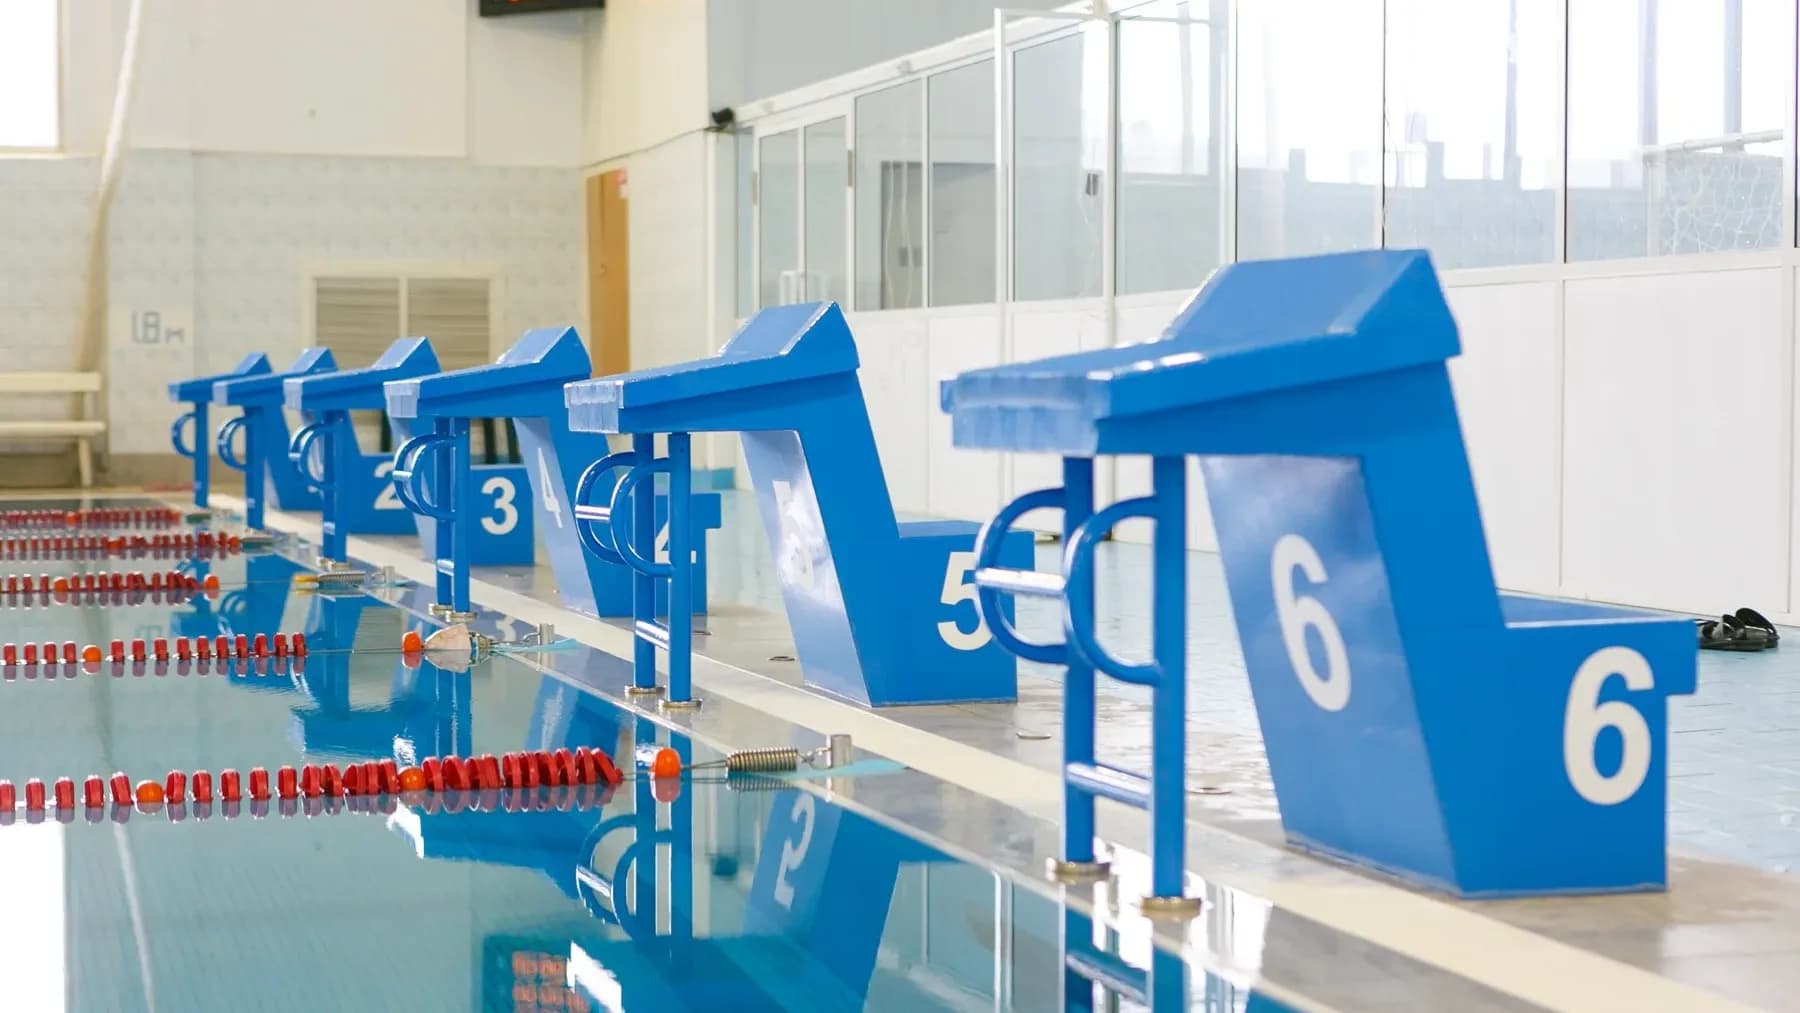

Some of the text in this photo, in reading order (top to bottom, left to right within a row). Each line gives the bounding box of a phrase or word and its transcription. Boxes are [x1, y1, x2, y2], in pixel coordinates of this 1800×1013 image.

[481, 477, 518, 534] 3
[538, 448, 563, 528] 4
[937, 551, 993, 650] 5
[1271, 534, 1352, 712] 6
[1563, 646, 1655, 805] 6
